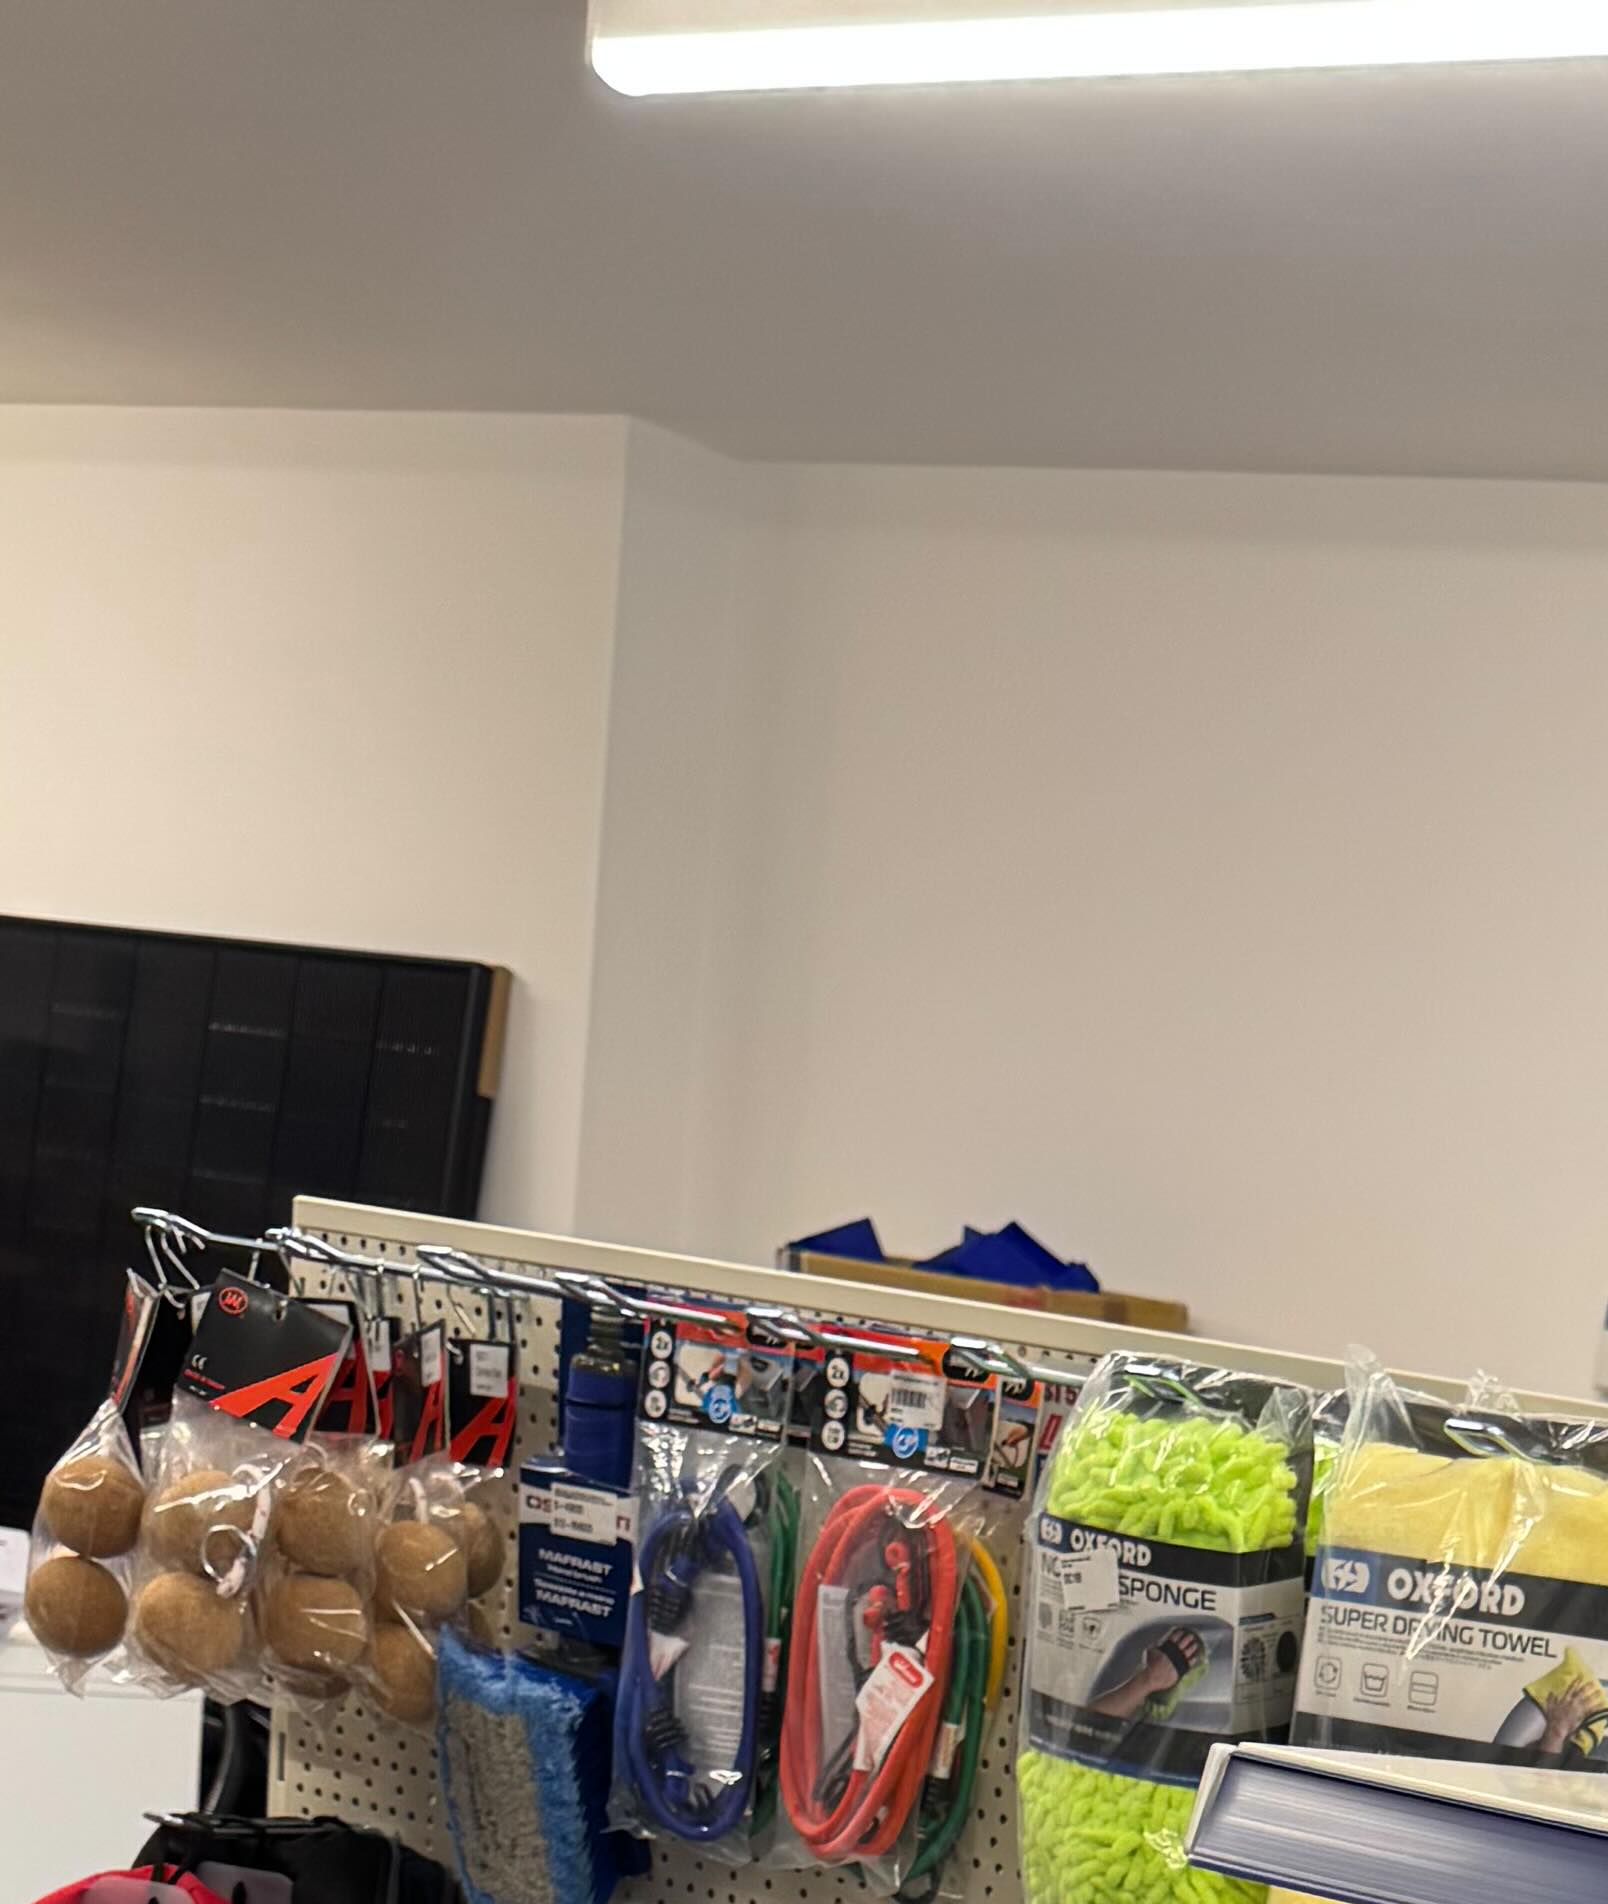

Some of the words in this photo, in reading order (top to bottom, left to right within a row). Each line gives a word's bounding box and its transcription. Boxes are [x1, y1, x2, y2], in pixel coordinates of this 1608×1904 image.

[1118, 1574, 1217, 1612] SPONGE
[1387, 1566, 1526, 1617] OXFORD
[1320, 1604, 1387, 1635] SUPER
[1392, 1616, 1475, 1647] DRYING
[1481, 1629, 1557, 1659] TOWEL
